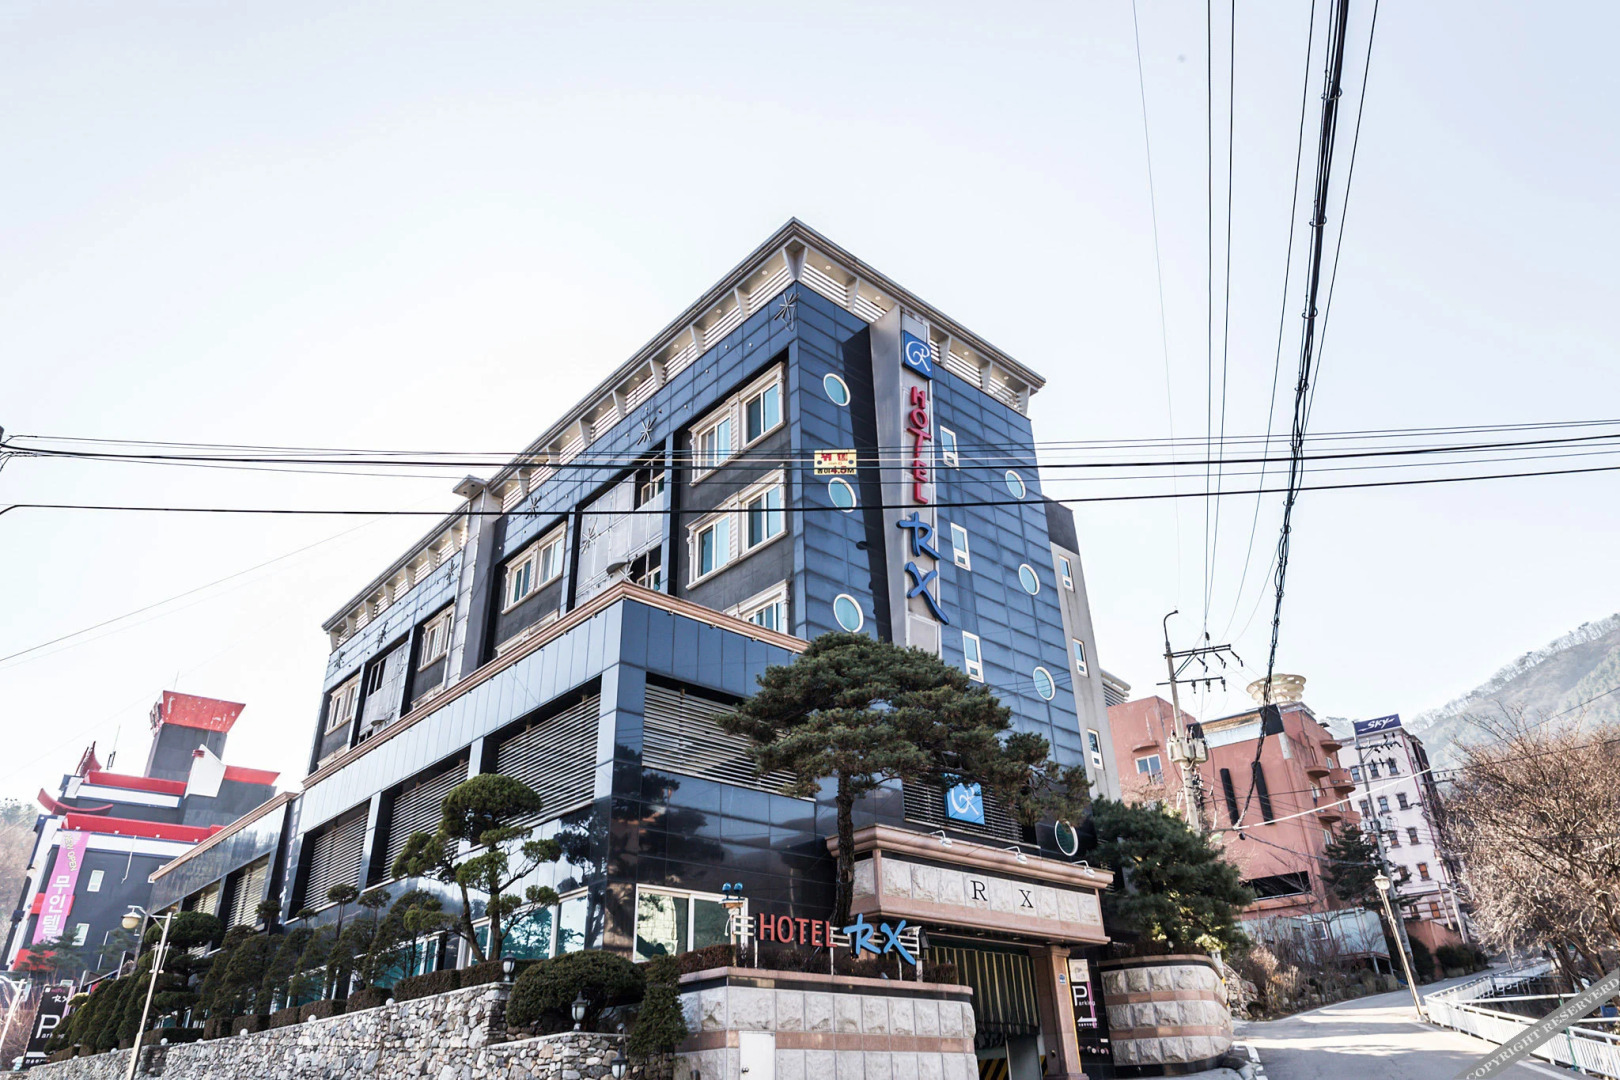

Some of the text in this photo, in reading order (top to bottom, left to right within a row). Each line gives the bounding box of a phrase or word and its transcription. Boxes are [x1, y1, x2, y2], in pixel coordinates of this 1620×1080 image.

[907, 386, 932, 505] HOTEL
[896, 511, 950, 626] RX
[1359, 717, 1395, 731] SKY
[42, 875, 71, 935] 무인텔
[759, 912, 917, 966] HOTEL RX
